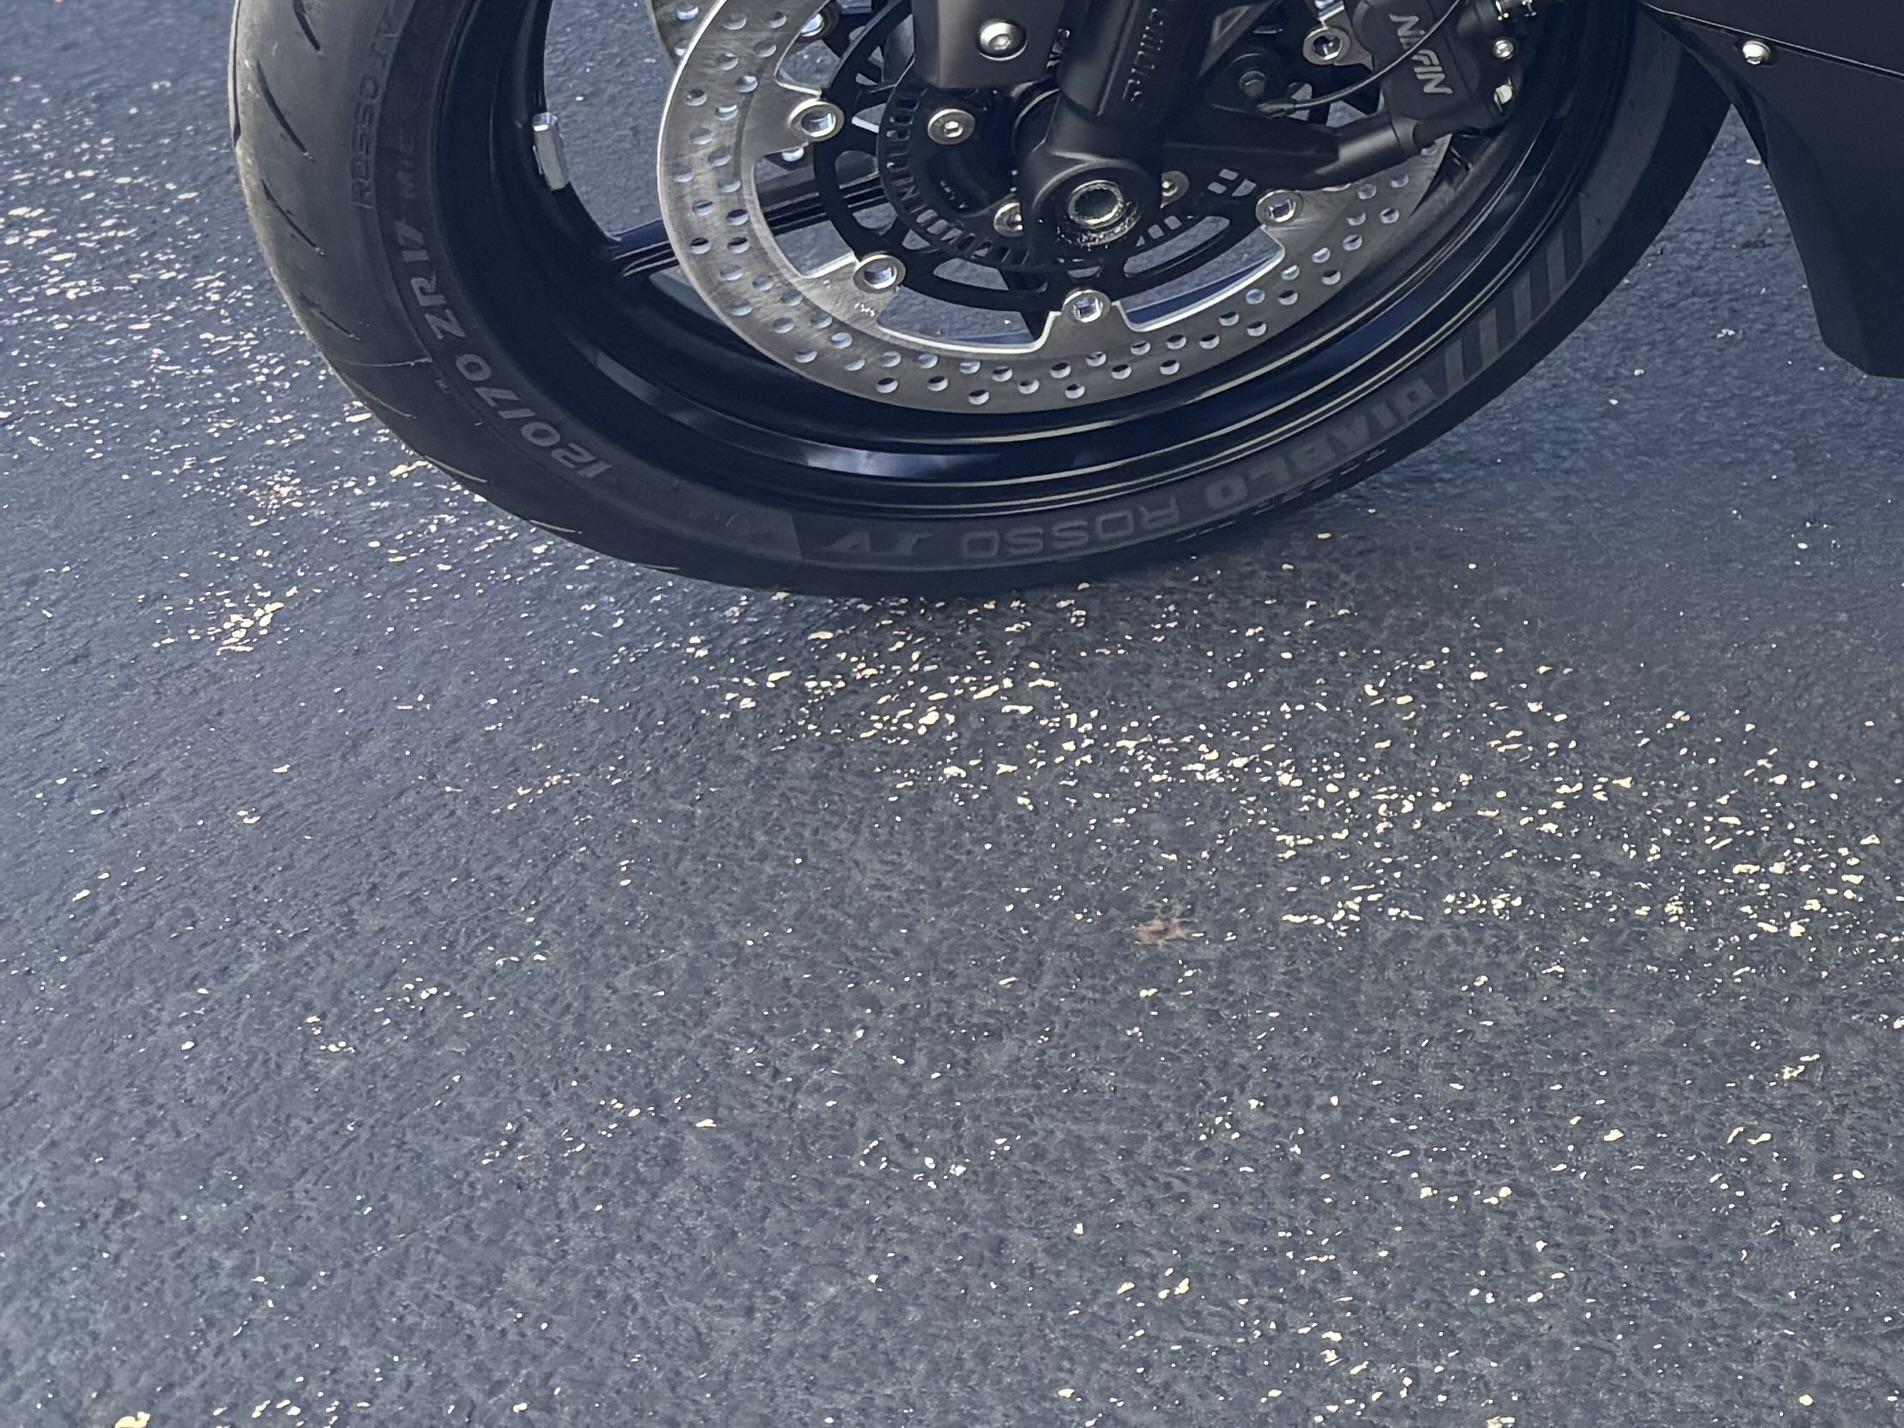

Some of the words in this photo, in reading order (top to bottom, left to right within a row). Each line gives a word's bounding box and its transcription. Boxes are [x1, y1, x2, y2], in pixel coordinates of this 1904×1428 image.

[1389, 15, 1453, 94] NISIN
[455, 353, 613, 481] 120/70
[1202, 379, 1439, 510] DIABLO
[963, 497, 1180, 560] ROSSO
